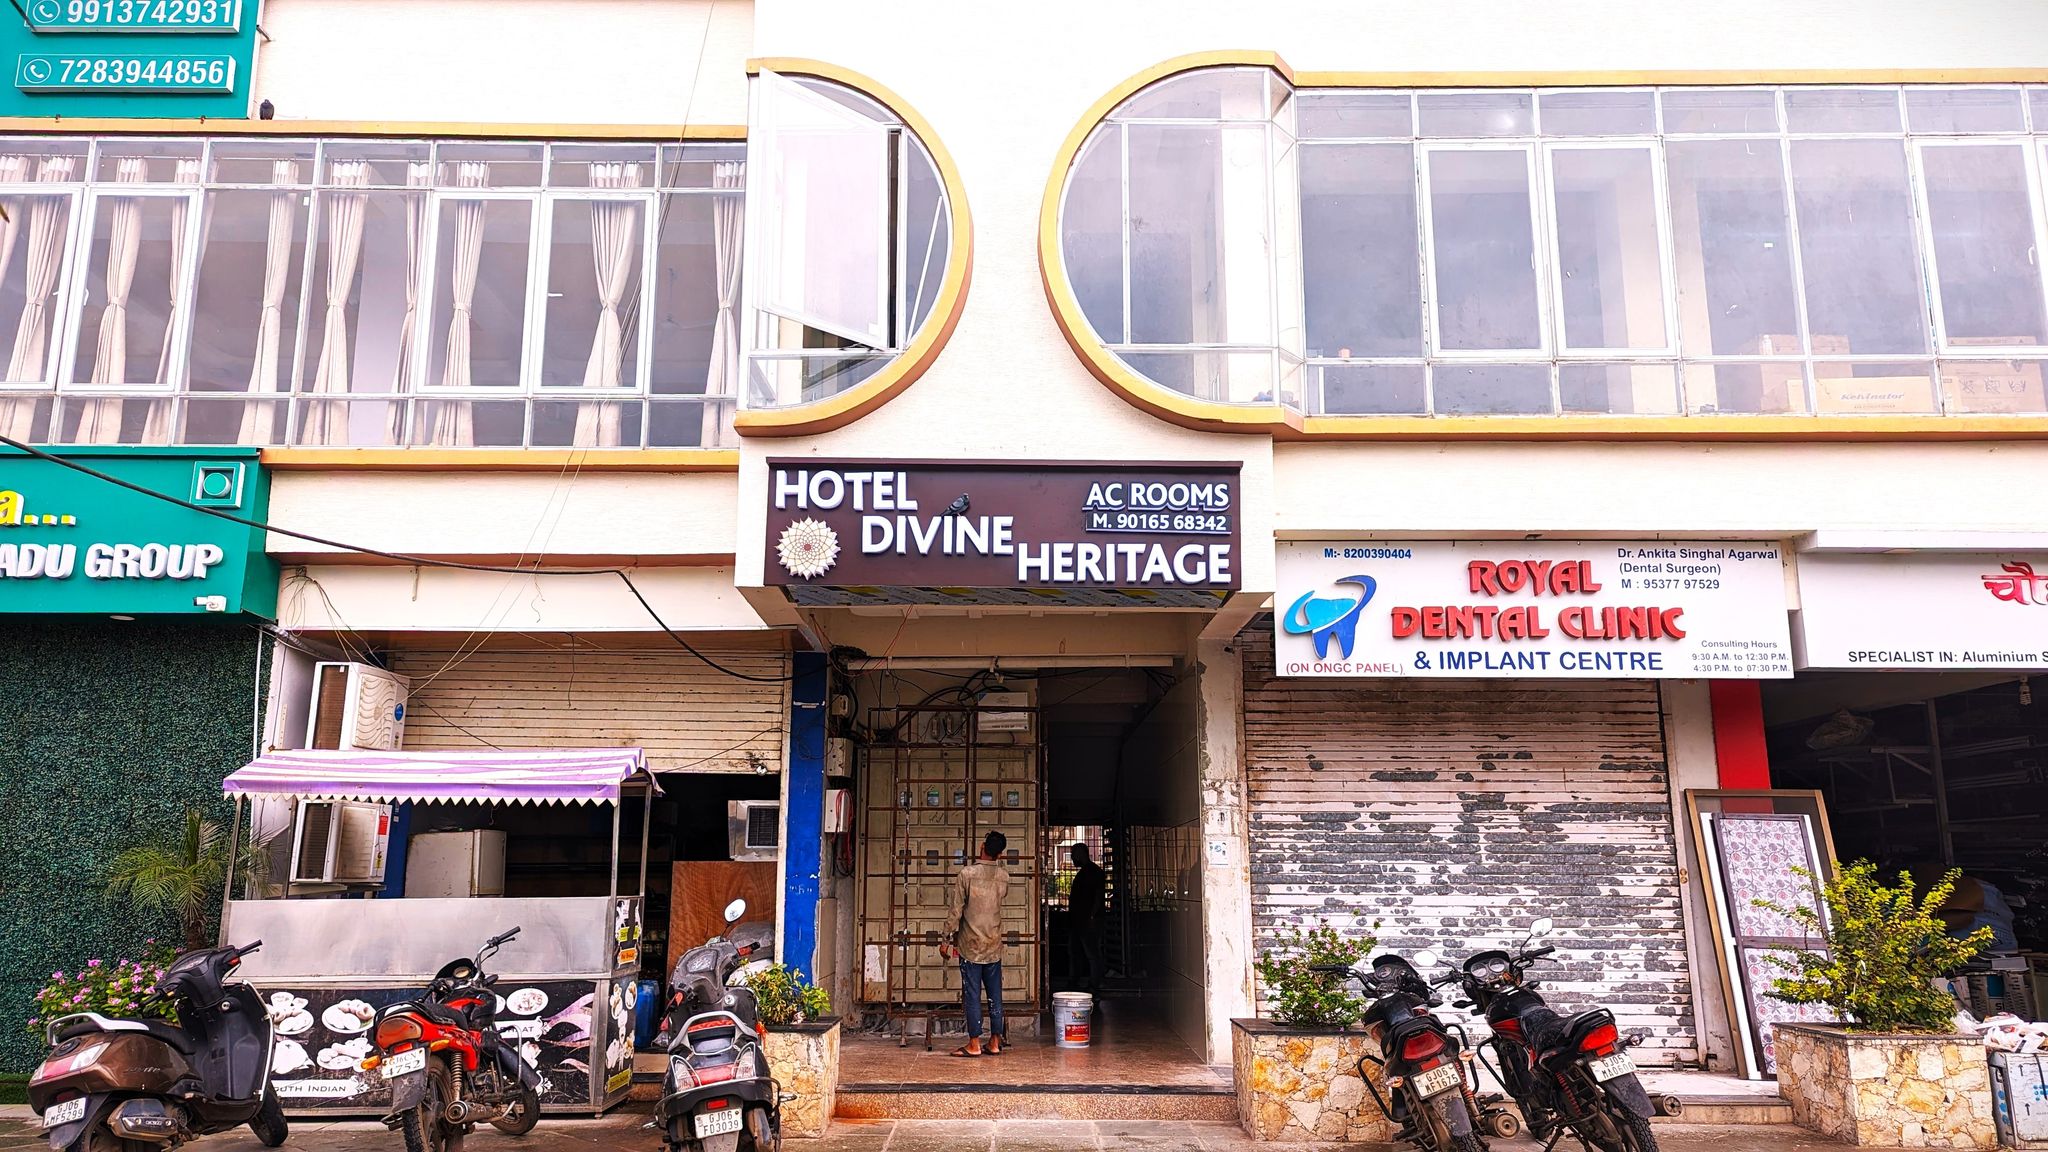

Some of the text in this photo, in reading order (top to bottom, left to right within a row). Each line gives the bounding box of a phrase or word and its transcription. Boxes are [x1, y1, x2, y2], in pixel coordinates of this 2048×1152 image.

[67, 0, 233, 23] 9913742931
[60, 60, 224, 84] 7283944856
[775, 469, 918, 511] HOTEL
[1085, 482, 1229, 507] AC ROOMS
[1092, 513, 1227, 531] M. 90165 68342
[861, 515, 1014, 555] DIVINE
[84, 542, 224, 579] GROUP
[1344, 548, 1412, 559] 8200390404
[1617, 548, 1778, 562] Dr. Ankita Singhal Agarwal
[1018, 542, 1232, 584] HERITAGE
[1619, 563, 1722, 576] (Dental Surgeon)
[1468, 560, 1602, 597] ROYAL
[1643, 578, 1679, 589] 95377
[1684, 578, 1720, 589] 97529
[1981, 561, 2048, 606] चौ
[1391, 605, 1687, 643] DENTAL CLINIC
[1701, 639, 1778, 650] Consulting Hours
[1414, 651, 1664, 671] & IMPLANT CENTRE
[1691, 653, 1789, 661] 9:30 A.M. to 12:30 P.M.
[1848, 651, 1934, 663] SPECIALIST
[1939, 651, 1958, 663] IN:
[1962, 651, 2038, 663] Aluminium
[1286, 663, 1404, 675] (ON ONGC PANEL)
[1693, 664, 1790, 673] 4:30 P.M. to 07:30 P.M.
[385, 1059, 421, 1076] 4752
[1602, 1054, 1625, 1068] GJ05
[1425, 1067, 1449, 1082] GJ06
[308, 1085, 347, 1093] INDIAN
[1424, 1074, 1459, 1093] MF1675
[57, 1100, 79, 1113] GJ06
[50, 1108, 83, 1125] MF5299
[708, 1110, 733, 1124] GJ06
